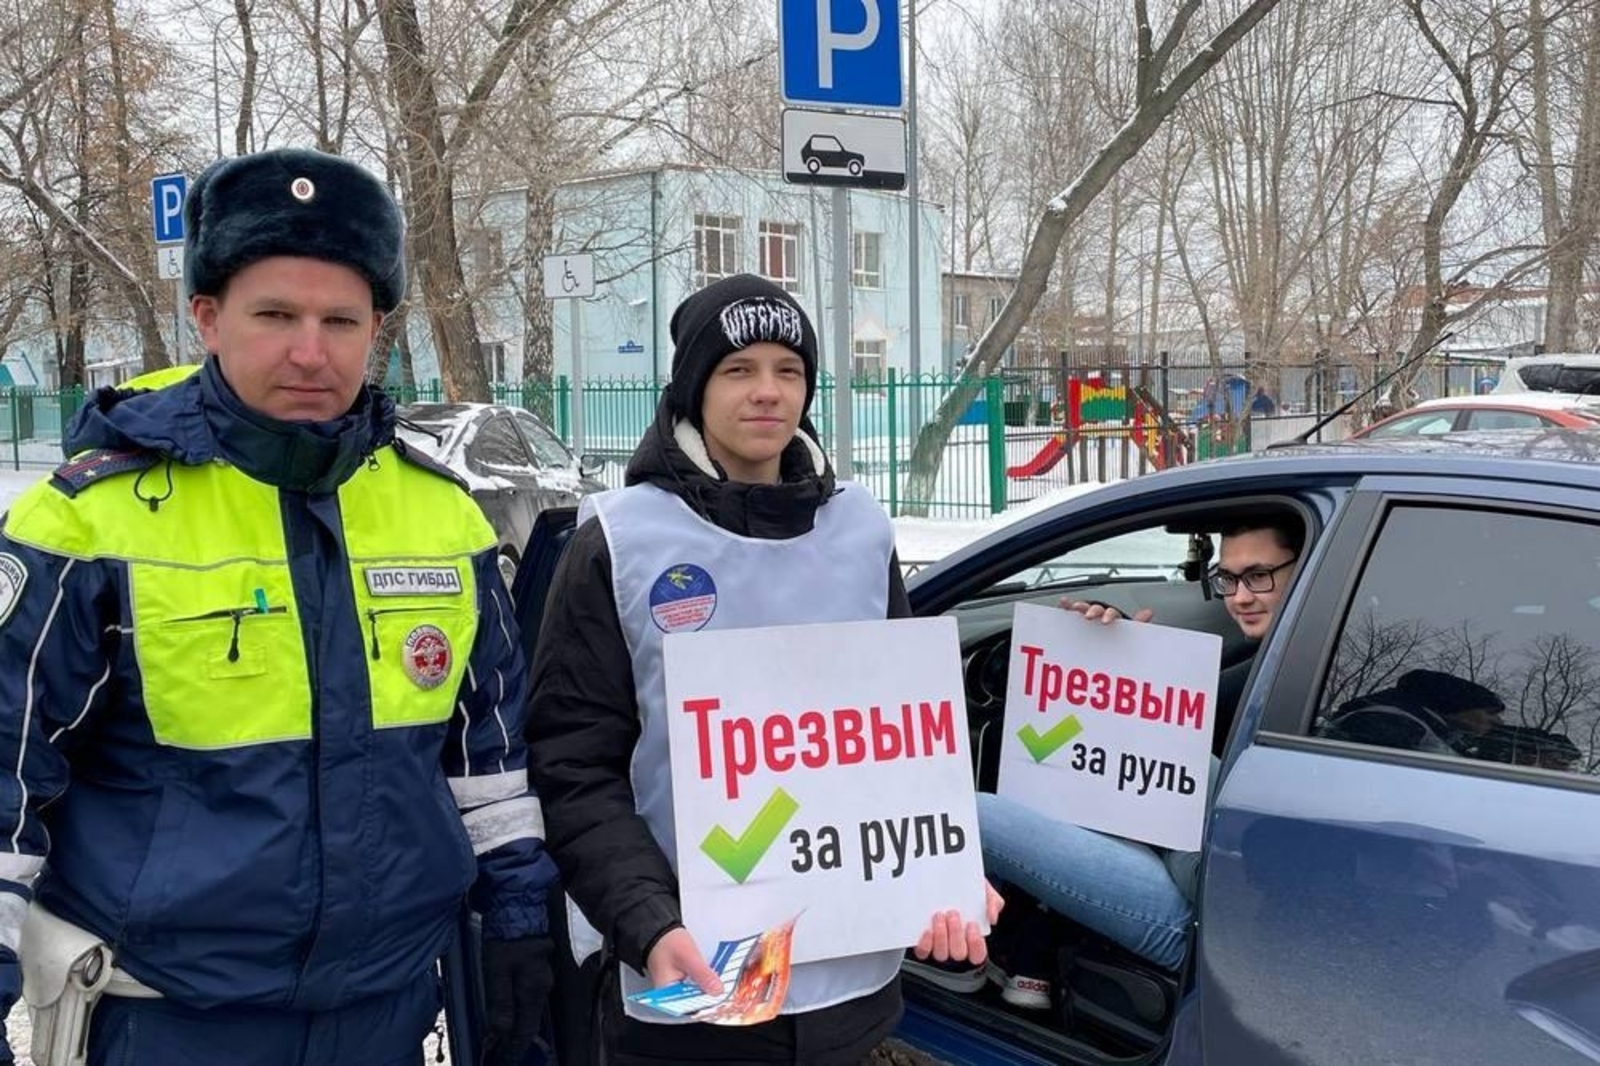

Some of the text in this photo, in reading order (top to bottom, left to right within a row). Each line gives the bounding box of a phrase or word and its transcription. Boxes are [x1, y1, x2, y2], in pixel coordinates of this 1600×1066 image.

[817, 0, 880, 89] P
[162, 184, 182, 236] P
[720, 297, 803, 349] WITCHER
[372, 571, 458, 589] ДПС ГИБДД
[1020, 645, 1206, 730] Трезвым
[683, 698, 957, 800] Трезвым
[1071, 743, 1196, 796] за руль
[789, 813, 966, 881] за руль
